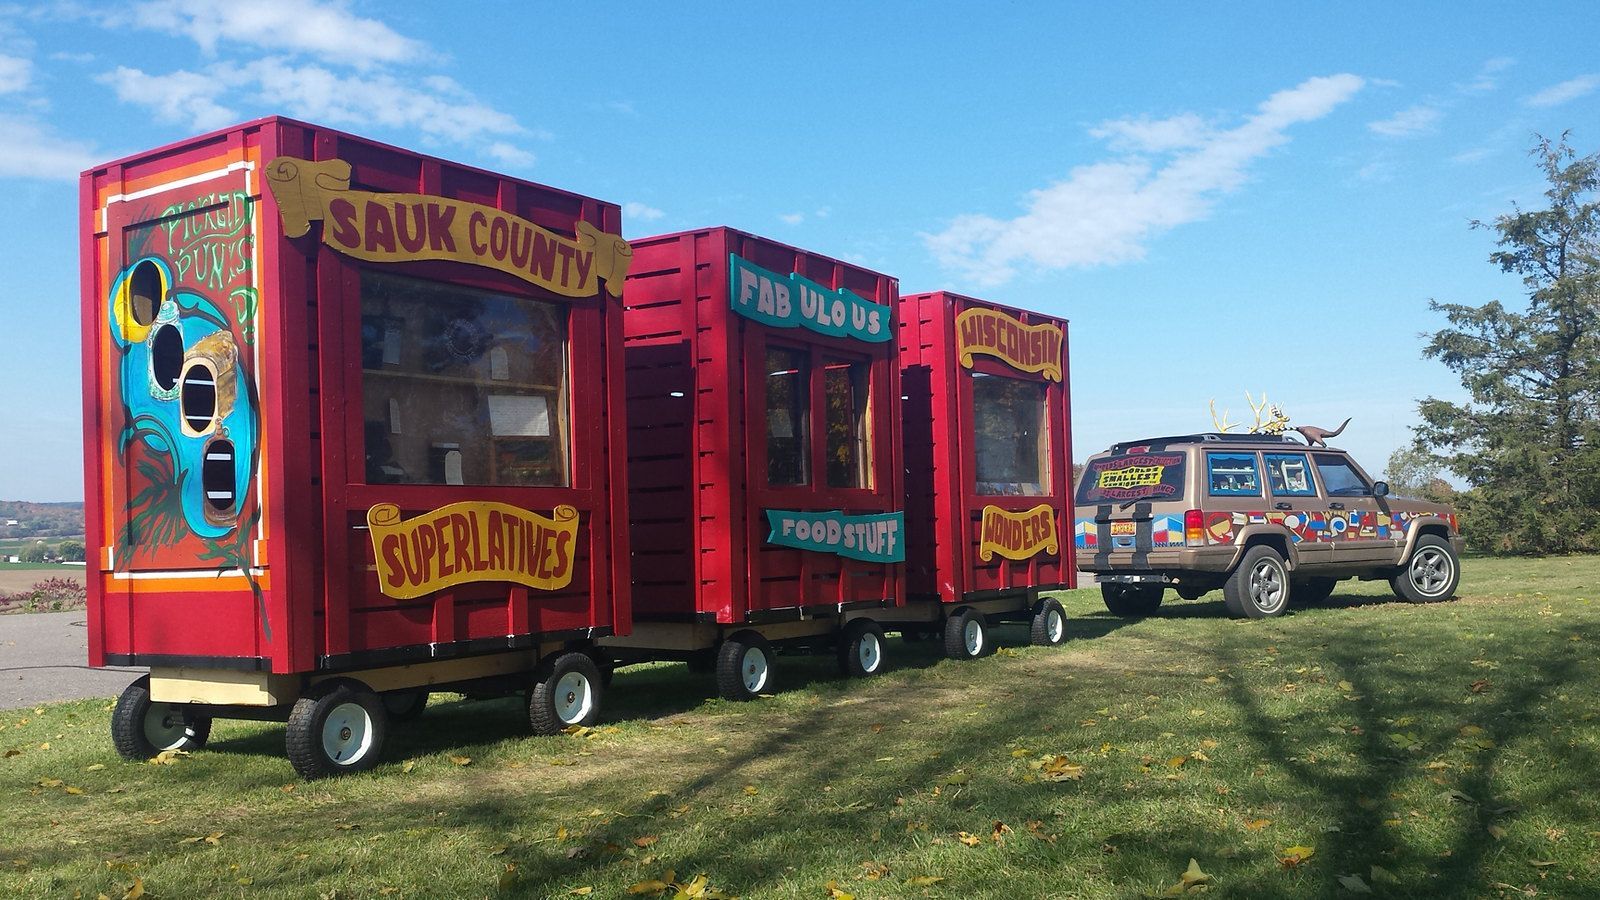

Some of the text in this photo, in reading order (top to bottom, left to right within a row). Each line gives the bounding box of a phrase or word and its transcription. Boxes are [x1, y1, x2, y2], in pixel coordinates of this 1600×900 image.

[329, 198, 594, 289] SAUK COUNTY
[960, 314, 1060, 367] WISCONSIN
[1103, 473, 1159, 483] SMALLEST
[381, 510, 571, 588] SUPERLATIVES
[984, 510, 1051, 552] WONDERS
